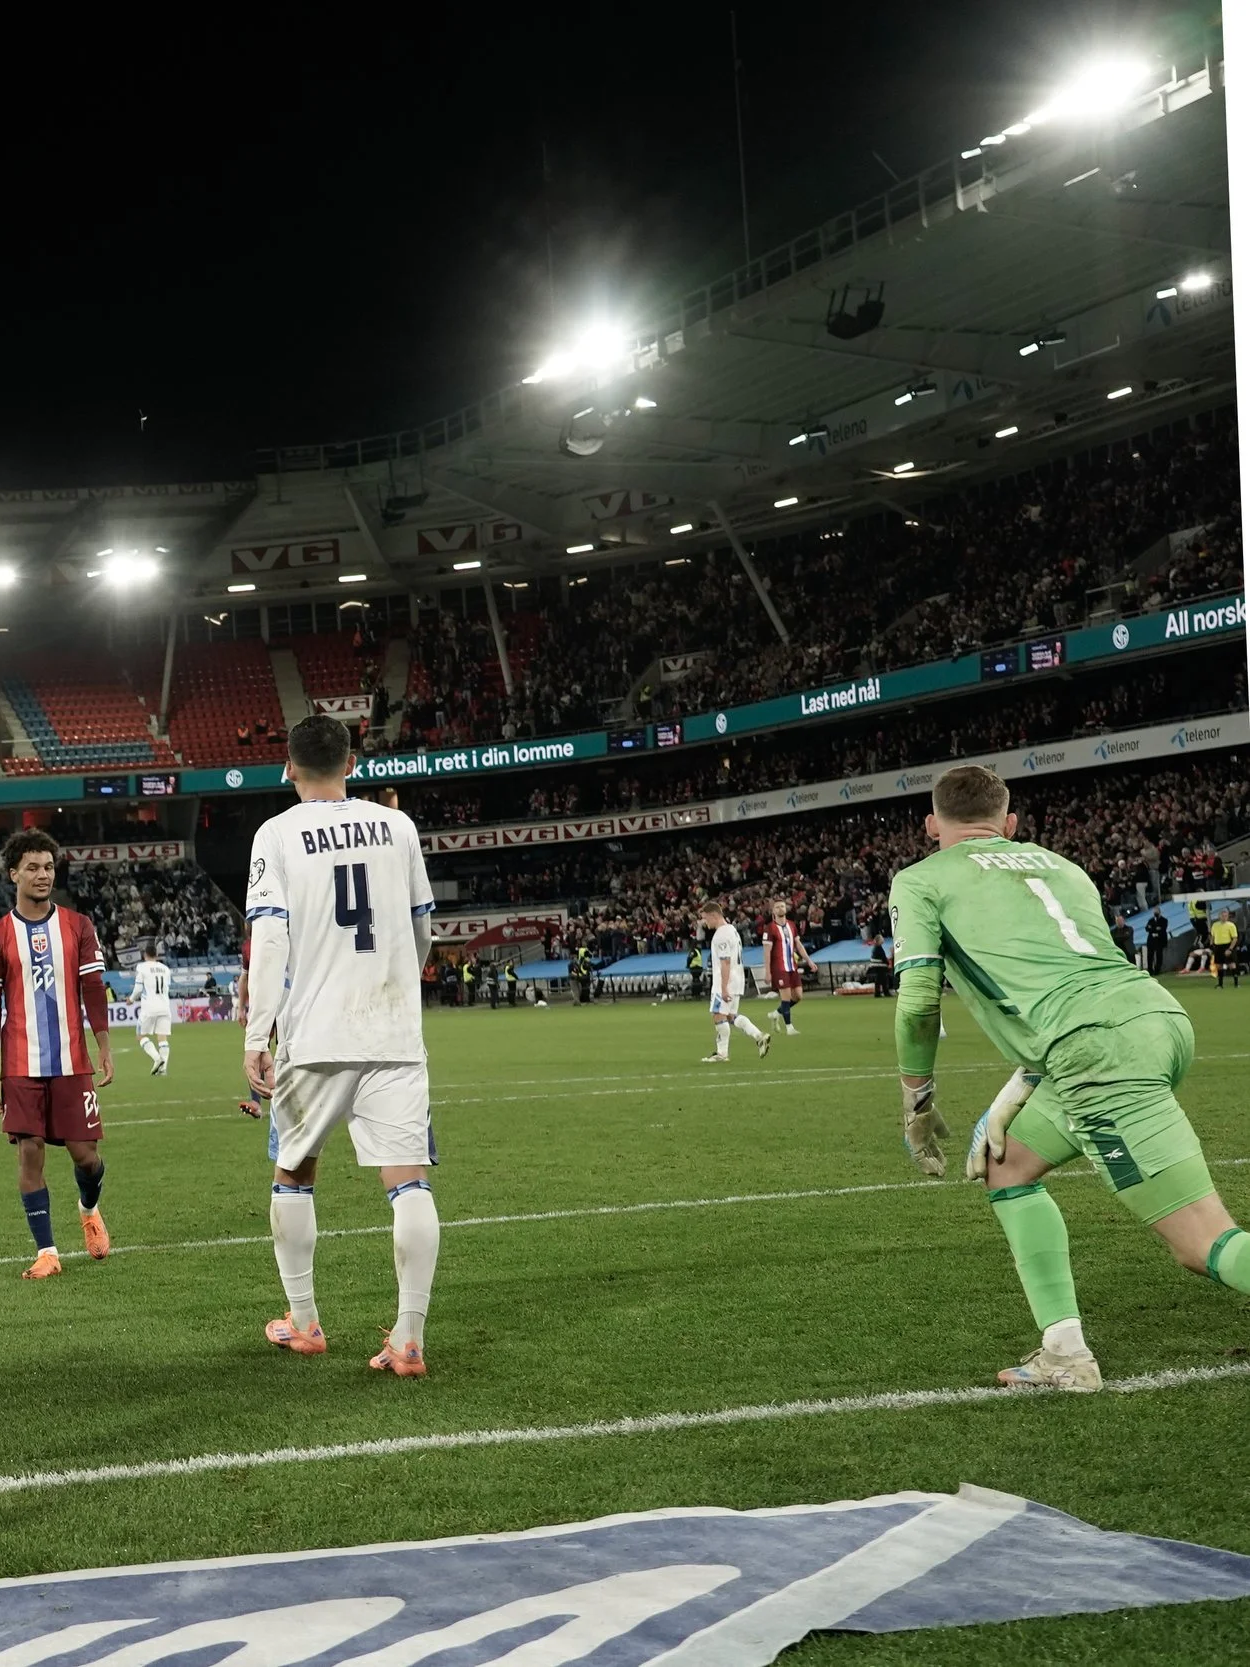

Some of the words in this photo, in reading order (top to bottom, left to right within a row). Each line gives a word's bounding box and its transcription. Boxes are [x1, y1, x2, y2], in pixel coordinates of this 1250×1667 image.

[420, 525, 518, 551] VG
[234, 541, 334, 572] VG
[1165, 610, 1189, 639] All
[1193, 598, 1246, 632] norsk
[318, 698, 369, 713] VG
[801, 691, 829, 715] Last
[831, 683, 856, 708] ned
[858, 678, 881, 702] nå!
[368, 755, 432, 777] fotball,
[435, 752, 468, 772] rett
[472, 750, 478, 769] i
[481, 747, 510, 767] din
[513, 742, 574, 763] lomme
[906, 773, 933, 786] telenor
[1035, 751, 1065, 766] telenor
[1107, 740, 1140, 755] telenor
[1186, 727, 1221, 743] telenor
[301, 821, 394, 855] BALTAXA
[439, 832, 494, 849] VG
[504, 826, 556, 842] VG
[565, 821, 614, 837] VG
[621, 814, 666, 832] VG
[69, 847, 115, 861] VG
[130, 843, 180, 858] VG
[968, 852, 1060, 870] PERETZ
[334, 863, 376, 953] 4
[1025, 878, 1097, 954] 1
[432, 921, 486, 936] VG
[32, 964, 55, 992] 22
[155, 975, 164, 994] 11
[83, 1090, 100, 1119] 22
